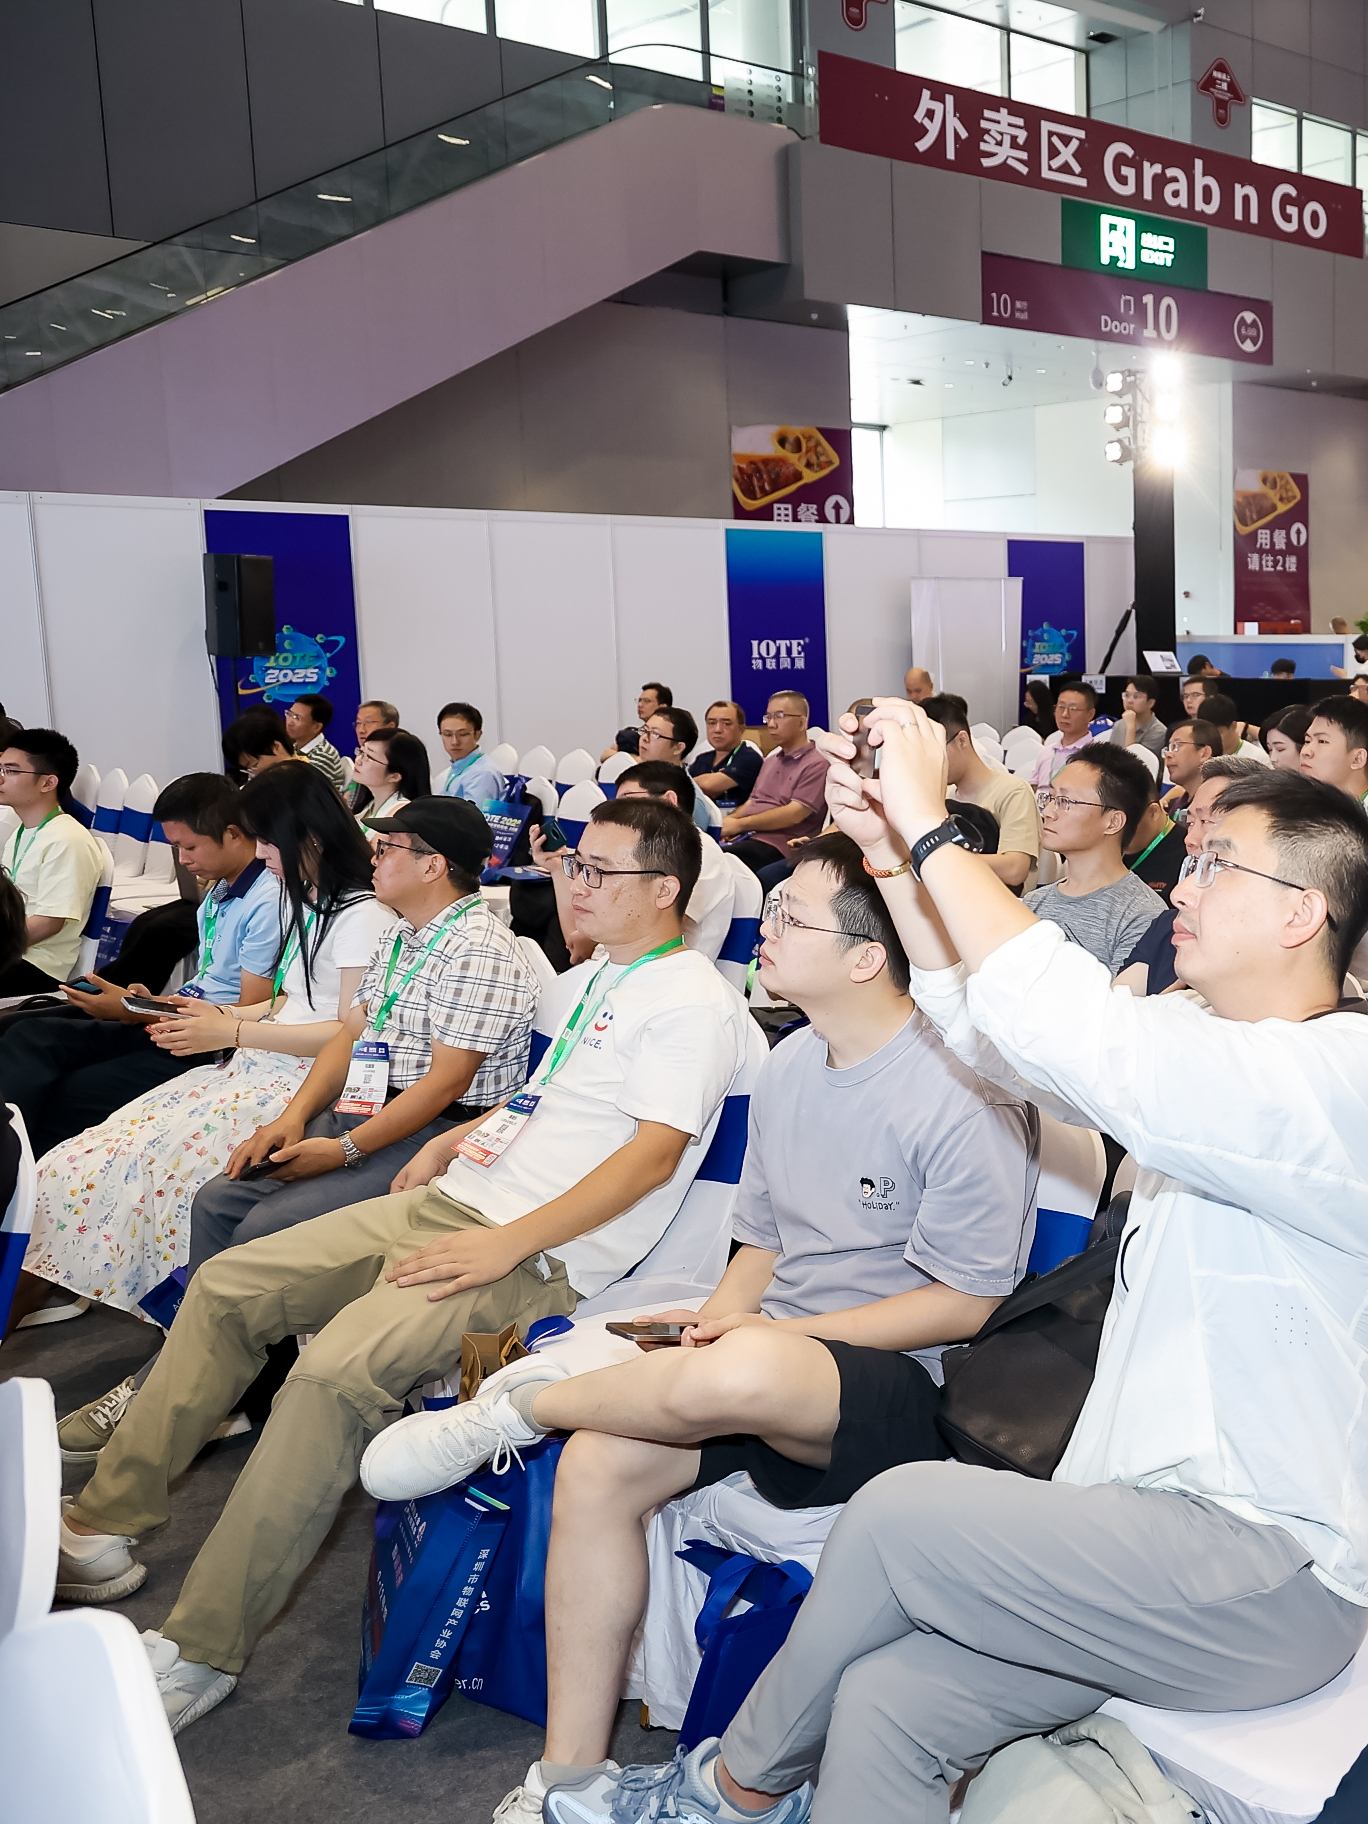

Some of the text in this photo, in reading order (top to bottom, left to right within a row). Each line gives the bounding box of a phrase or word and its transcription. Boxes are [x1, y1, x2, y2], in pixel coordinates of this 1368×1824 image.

[913, 87, 1328, 239] 外卖区 Grab n Go
[1140, 249, 1175, 267] EXIT
[990, 292, 1011, 318] 10
[1120, 294, 1134, 315] 门
[1101, 293, 1178, 341] Door 10
[773, 502, 819, 523] 用餐
[1256, 528, 1287, 550] 用餐
[1247, 553, 1297, 572] 请往2楼
[751, 639, 806, 659] IOTE
[1032, 653, 1063, 664] 2025
[751, 658, 806, 671] 物联网展
[264, 668, 320, 683] 2025
[429, 1548, 491, 1660] 深圳市物联网产业协会
